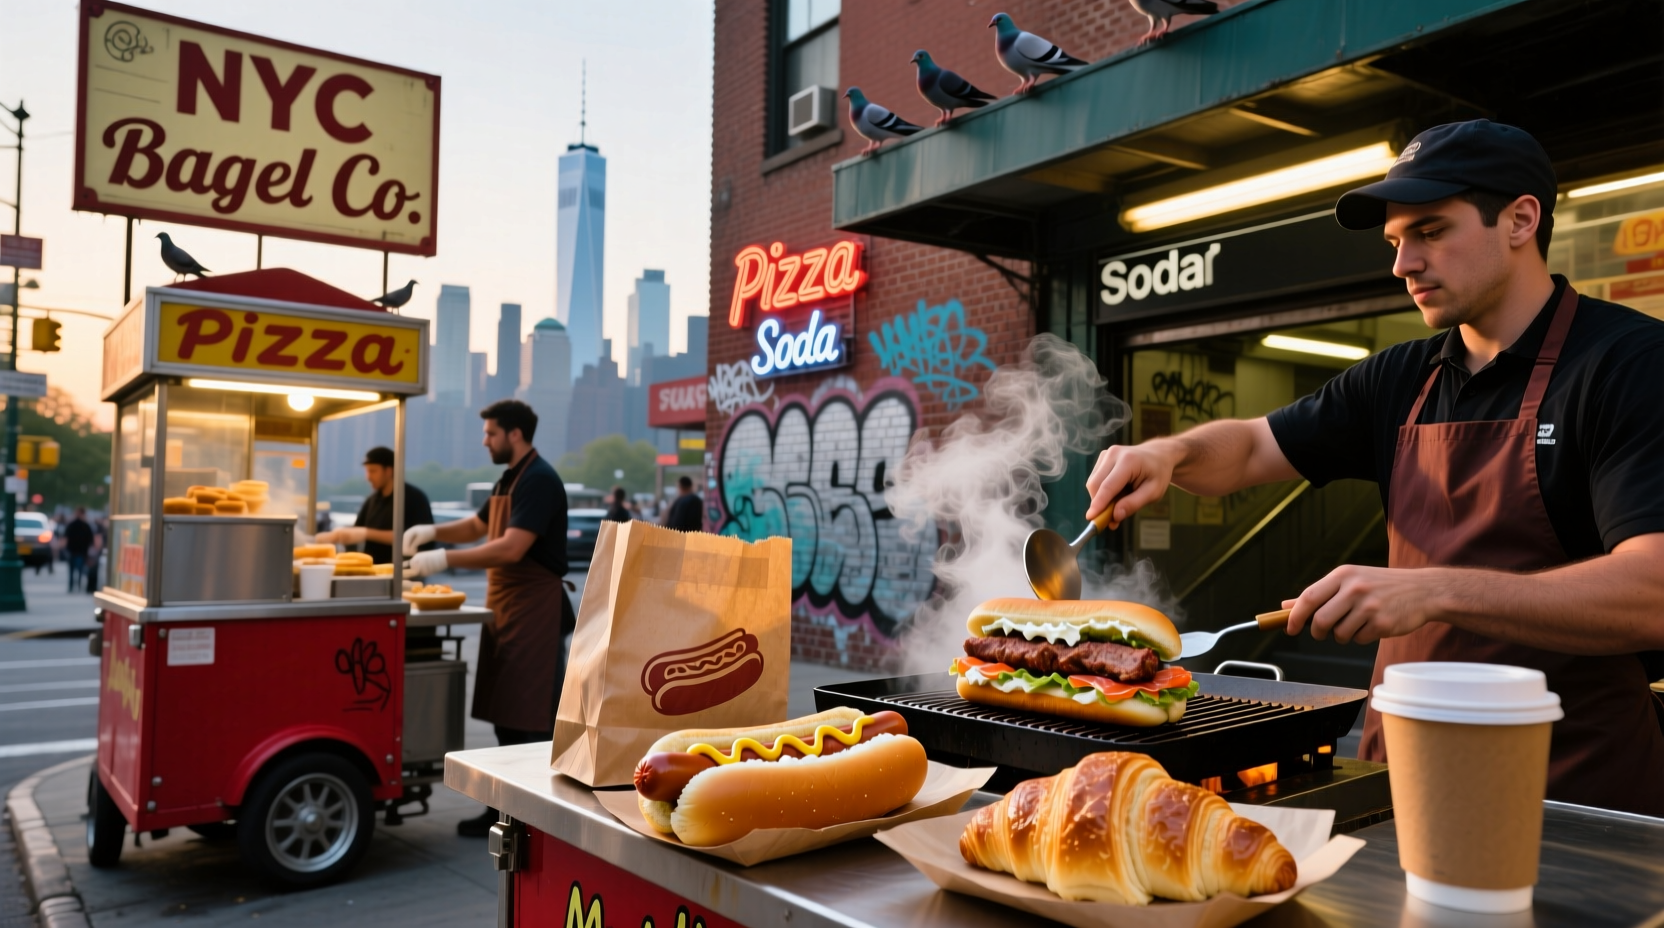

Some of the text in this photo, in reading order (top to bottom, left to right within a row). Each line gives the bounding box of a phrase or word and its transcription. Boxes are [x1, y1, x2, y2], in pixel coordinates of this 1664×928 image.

[177, 40, 375, 144] NYC
[102, 117, 421, 225] Bagel Co.
[729, 240, 861, 329] Pizza
[176, 307, 404, 377] Pizza
[751, 309, 840, 376] Soda
